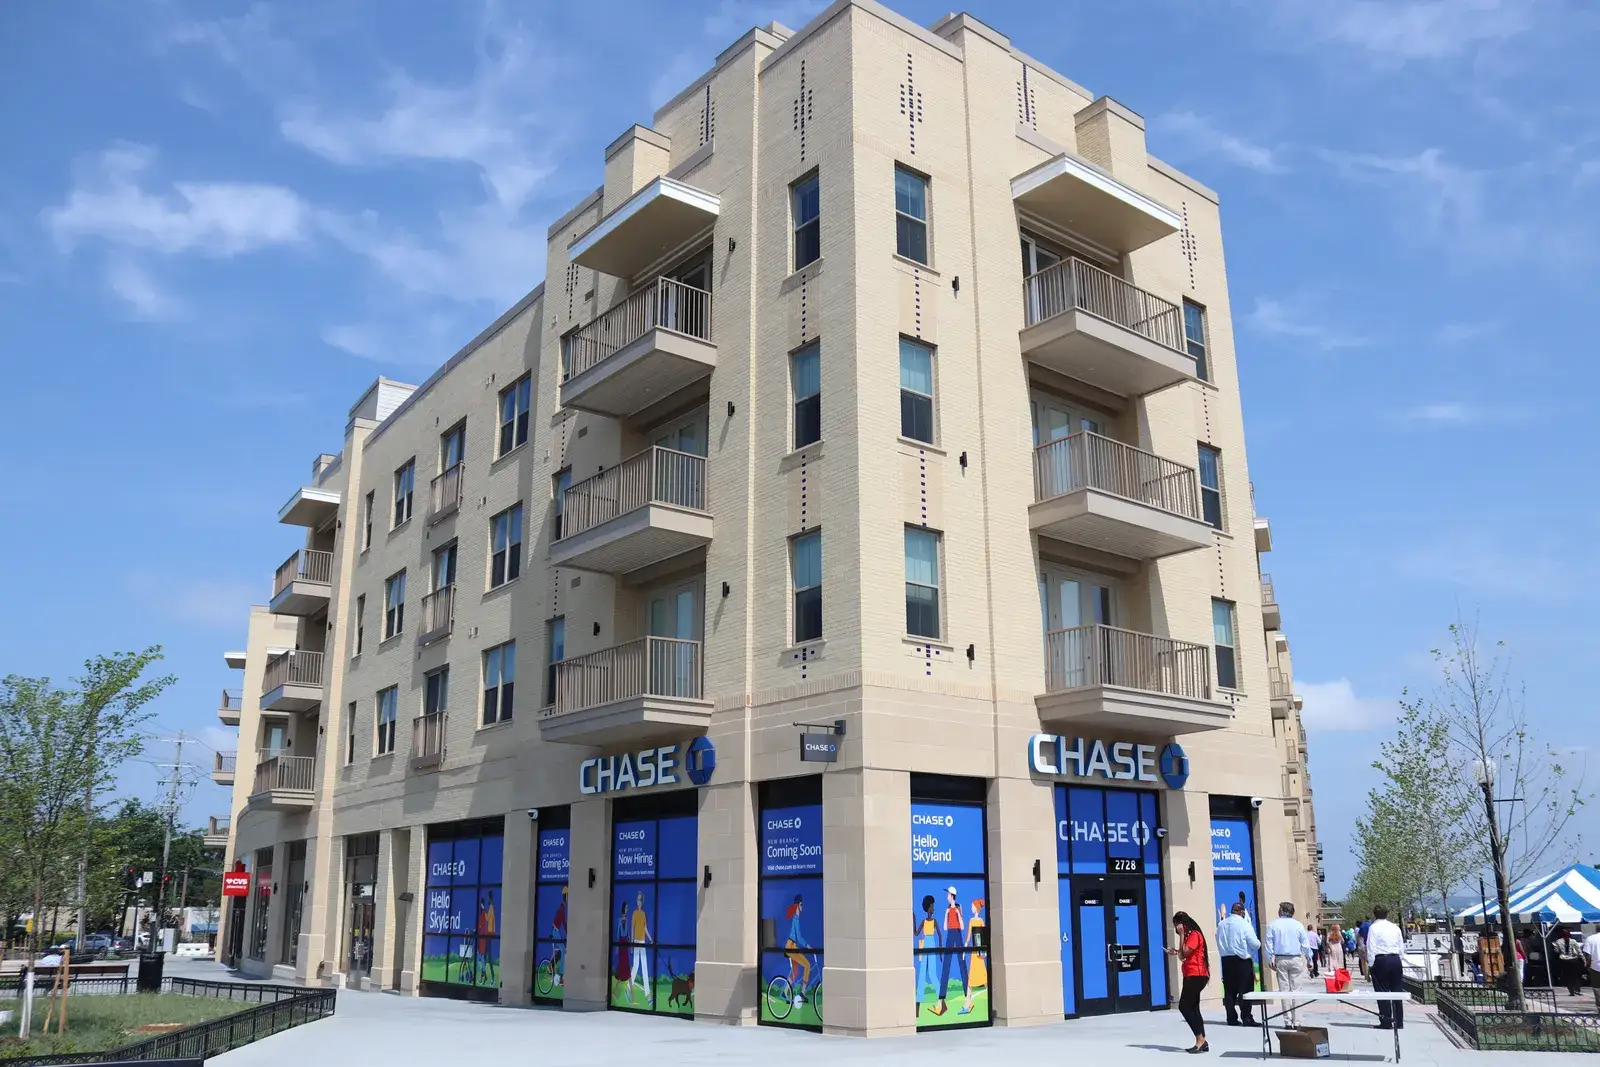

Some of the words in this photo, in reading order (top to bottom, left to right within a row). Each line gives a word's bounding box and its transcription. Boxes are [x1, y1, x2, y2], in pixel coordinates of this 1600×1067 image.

[806, 744, 828, 752] CHASE
[1028, 734, 1158, 782] CHASE
[579, 745, 679, 794] CHASE
[768, 820, 793, 830] CHASE
[912, 815, 944, 826] CHASE
[619, 831, 639, 840] CHASE
[1059, 820, 1129, 843] CHASE
[543, 838, 559, 846] CHASE
[913, 834, 938, 848] Hello
[767, 845, 798, 860] Coming
[800, 844, 821, 856] Soon
[912, 848, 952, 865] Skyland
[1221, 850, 1241, 863] Hiring
[542, 858, 562, 870] Coming
[618, 854, 633, 864] Now
[634, 853, 653, 866] Hiring
[1115, 860, 1136, 870] 2728
[432, 862, 458, 876] CHASE
[431, 890, 450, 909] Hello
[430, 911, 460, 933] Skyland
